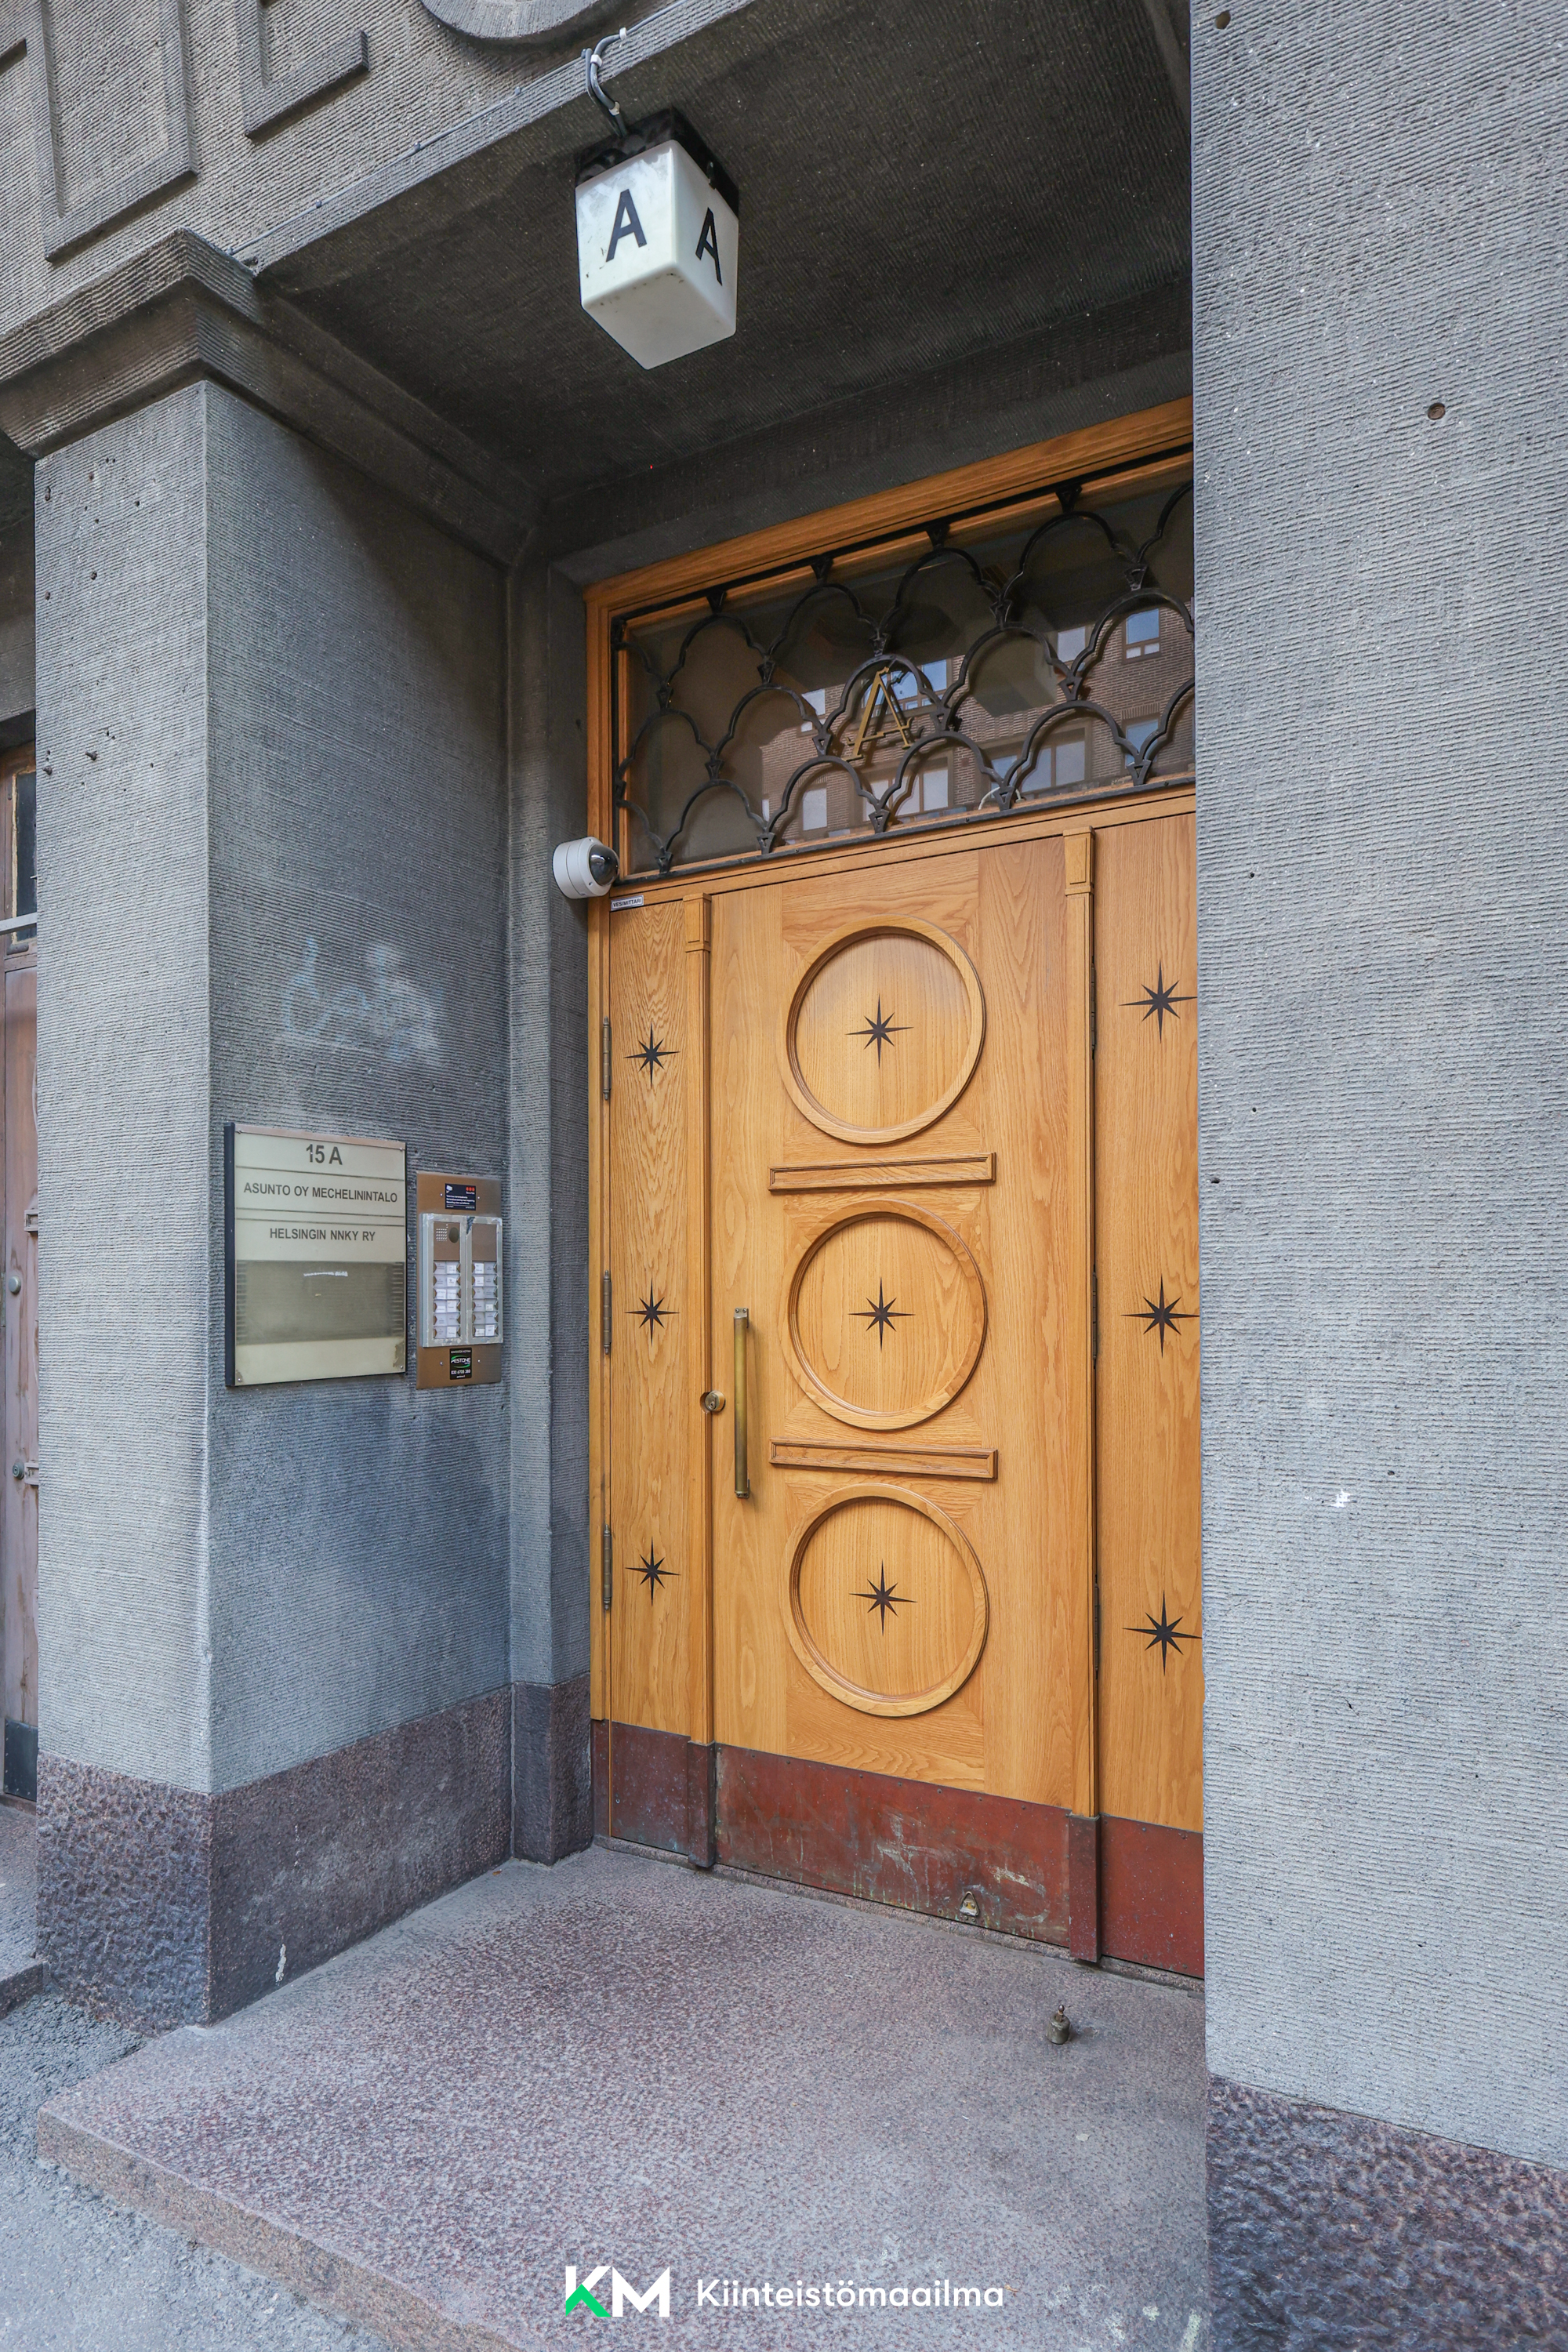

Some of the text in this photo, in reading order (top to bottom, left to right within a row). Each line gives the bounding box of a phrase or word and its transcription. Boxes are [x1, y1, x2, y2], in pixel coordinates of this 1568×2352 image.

[605, 188, 648, 263] A
[695, 206, 723, 287] A
[842, 666, 914, 762] A
[612, 898, 642, 907] VESIMITTARI
[306, 1144, 343, 1165] 15 A
[244, 1182, 397, 1203] ASUNTO OY MECHELININTALO
[270, 1228, 376, 1241] HELSINGIN NNKY RY
